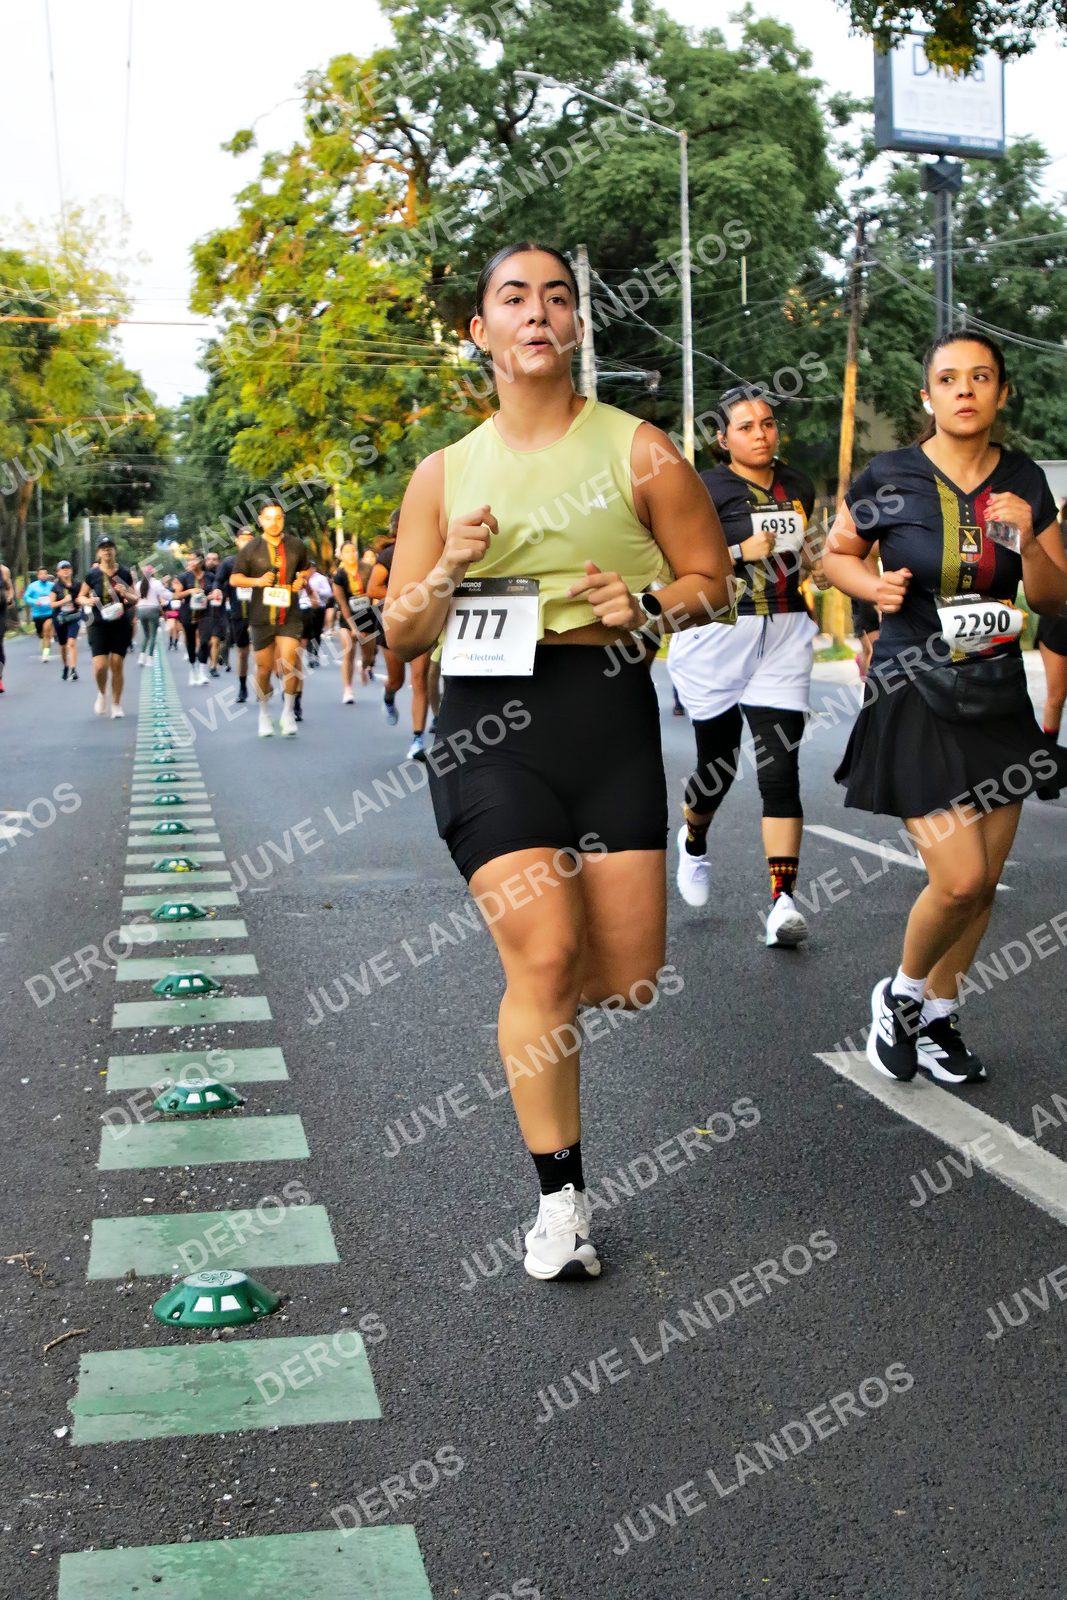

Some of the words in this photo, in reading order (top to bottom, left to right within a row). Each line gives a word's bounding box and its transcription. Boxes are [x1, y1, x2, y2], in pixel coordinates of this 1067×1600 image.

[761, 517, 796, 534] 6935
[455, 608, 508, 640] 777
[953, 609, 1011, 638] 2290
